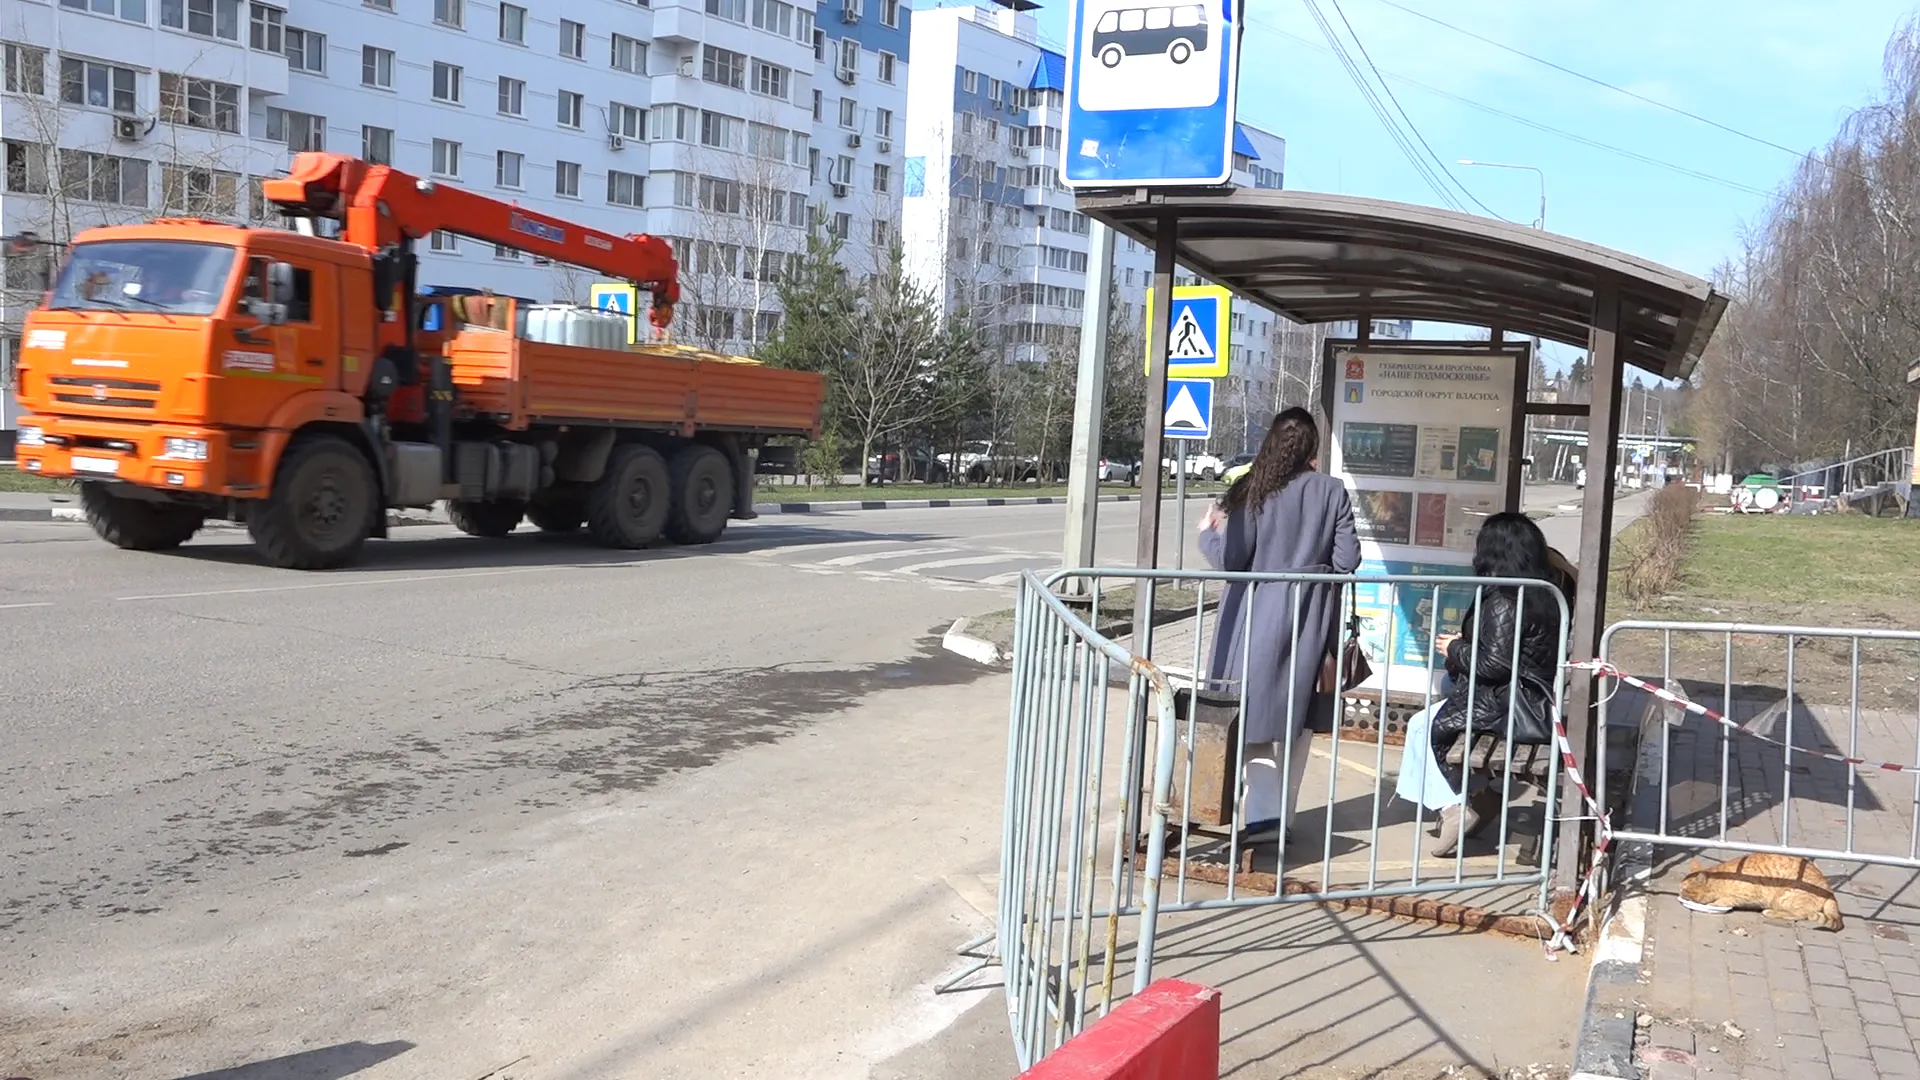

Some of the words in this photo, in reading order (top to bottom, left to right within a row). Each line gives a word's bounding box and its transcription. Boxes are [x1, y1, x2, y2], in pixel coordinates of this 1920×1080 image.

[1379, 363, 1444, 371] ГУБЕРНАТОРСКАЯ
[1445, 364, 1492, 372] ПРОГРАММА
[1378, 371, 1412, 380] «НАШЕ
[1414, 371, 1491, 381] ПОДМОСКОВЬЕ»
[1371, 389, 1424, 399] ГОРОДСКОЙ
[1425, 391, 1454, 400] ОКРУГ
[1456, 391, 1500, 401] ВЛАСИХА
